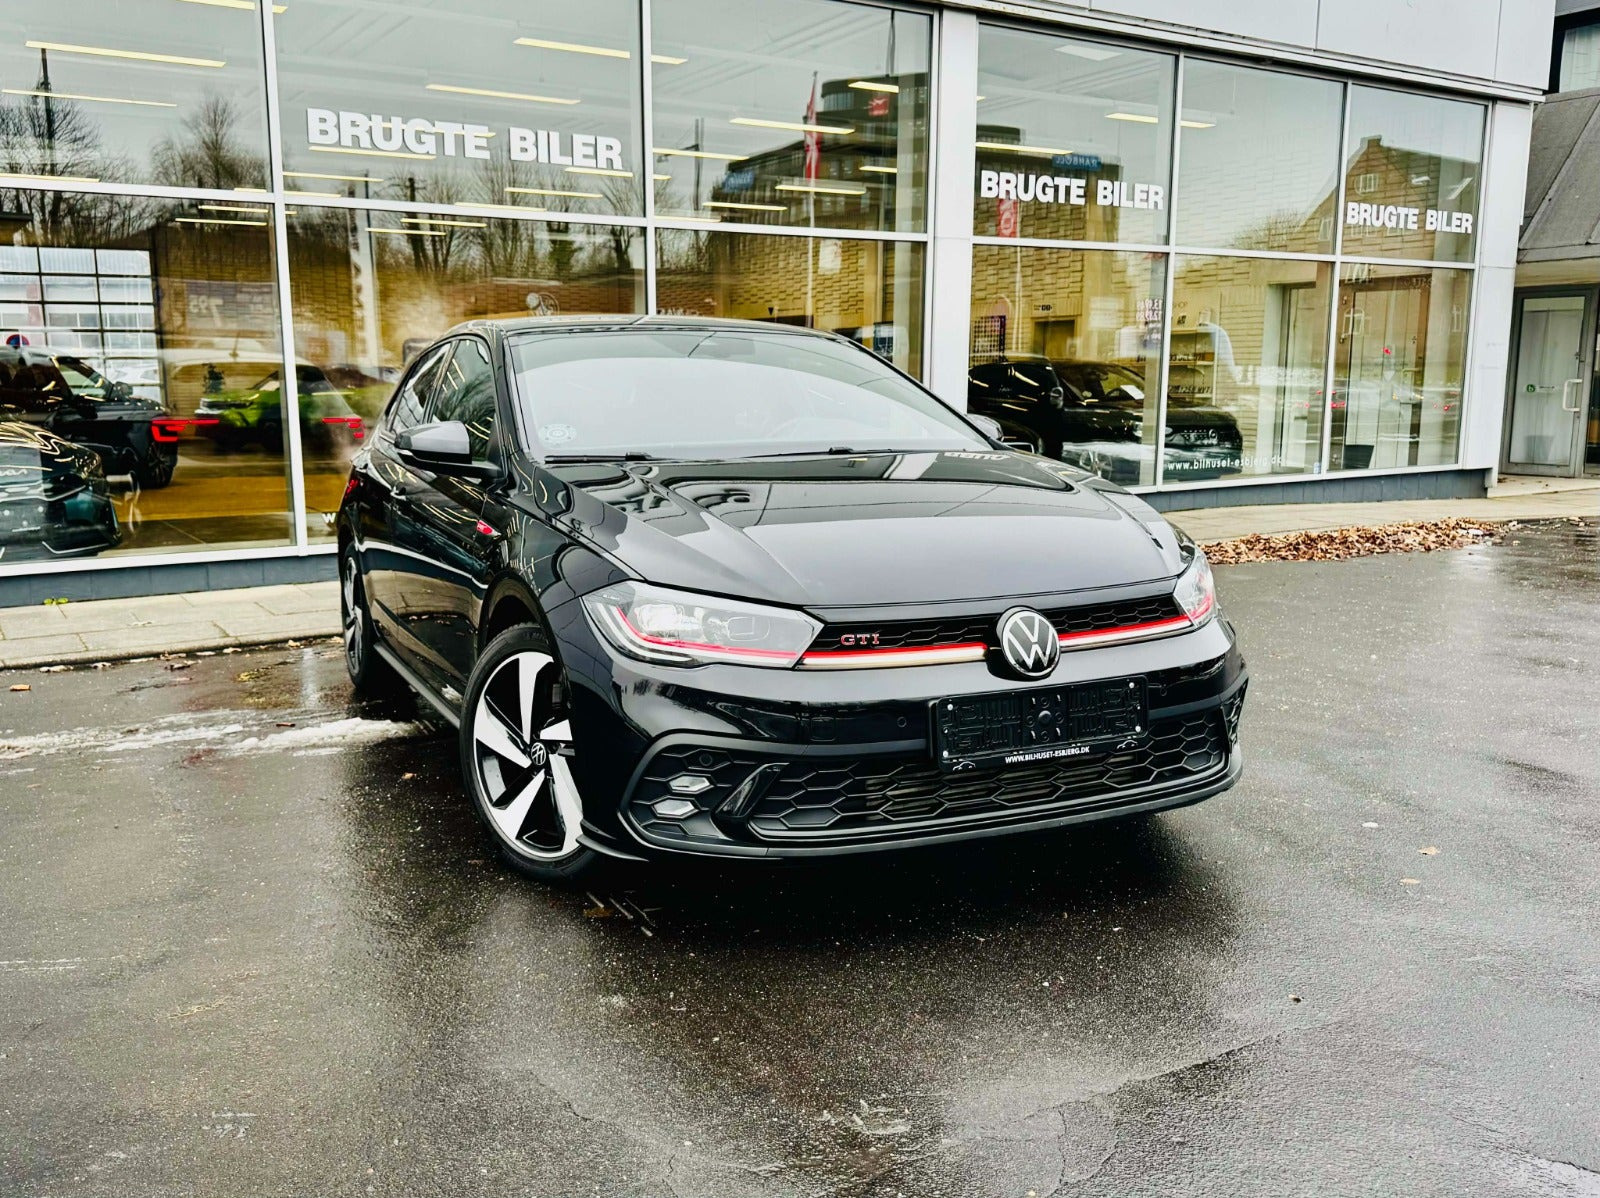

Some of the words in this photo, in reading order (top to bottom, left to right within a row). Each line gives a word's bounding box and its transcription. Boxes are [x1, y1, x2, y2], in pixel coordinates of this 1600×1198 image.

[307, 108, 490, 159] BRUGTE
[509, 127, 623, 169] BILER
[981, 170, 1086, 206] BRUGTE
[1096, 179, 1164, 210] BILER
[1346, 201, 1420, 230] BRUGTE
[1425, 209, 1474, 234] BILER
[840, 633, 880, 646] GTI
[1004, 746, 1091, 764] WWW.BILHUSET-ESBJERG.DK
